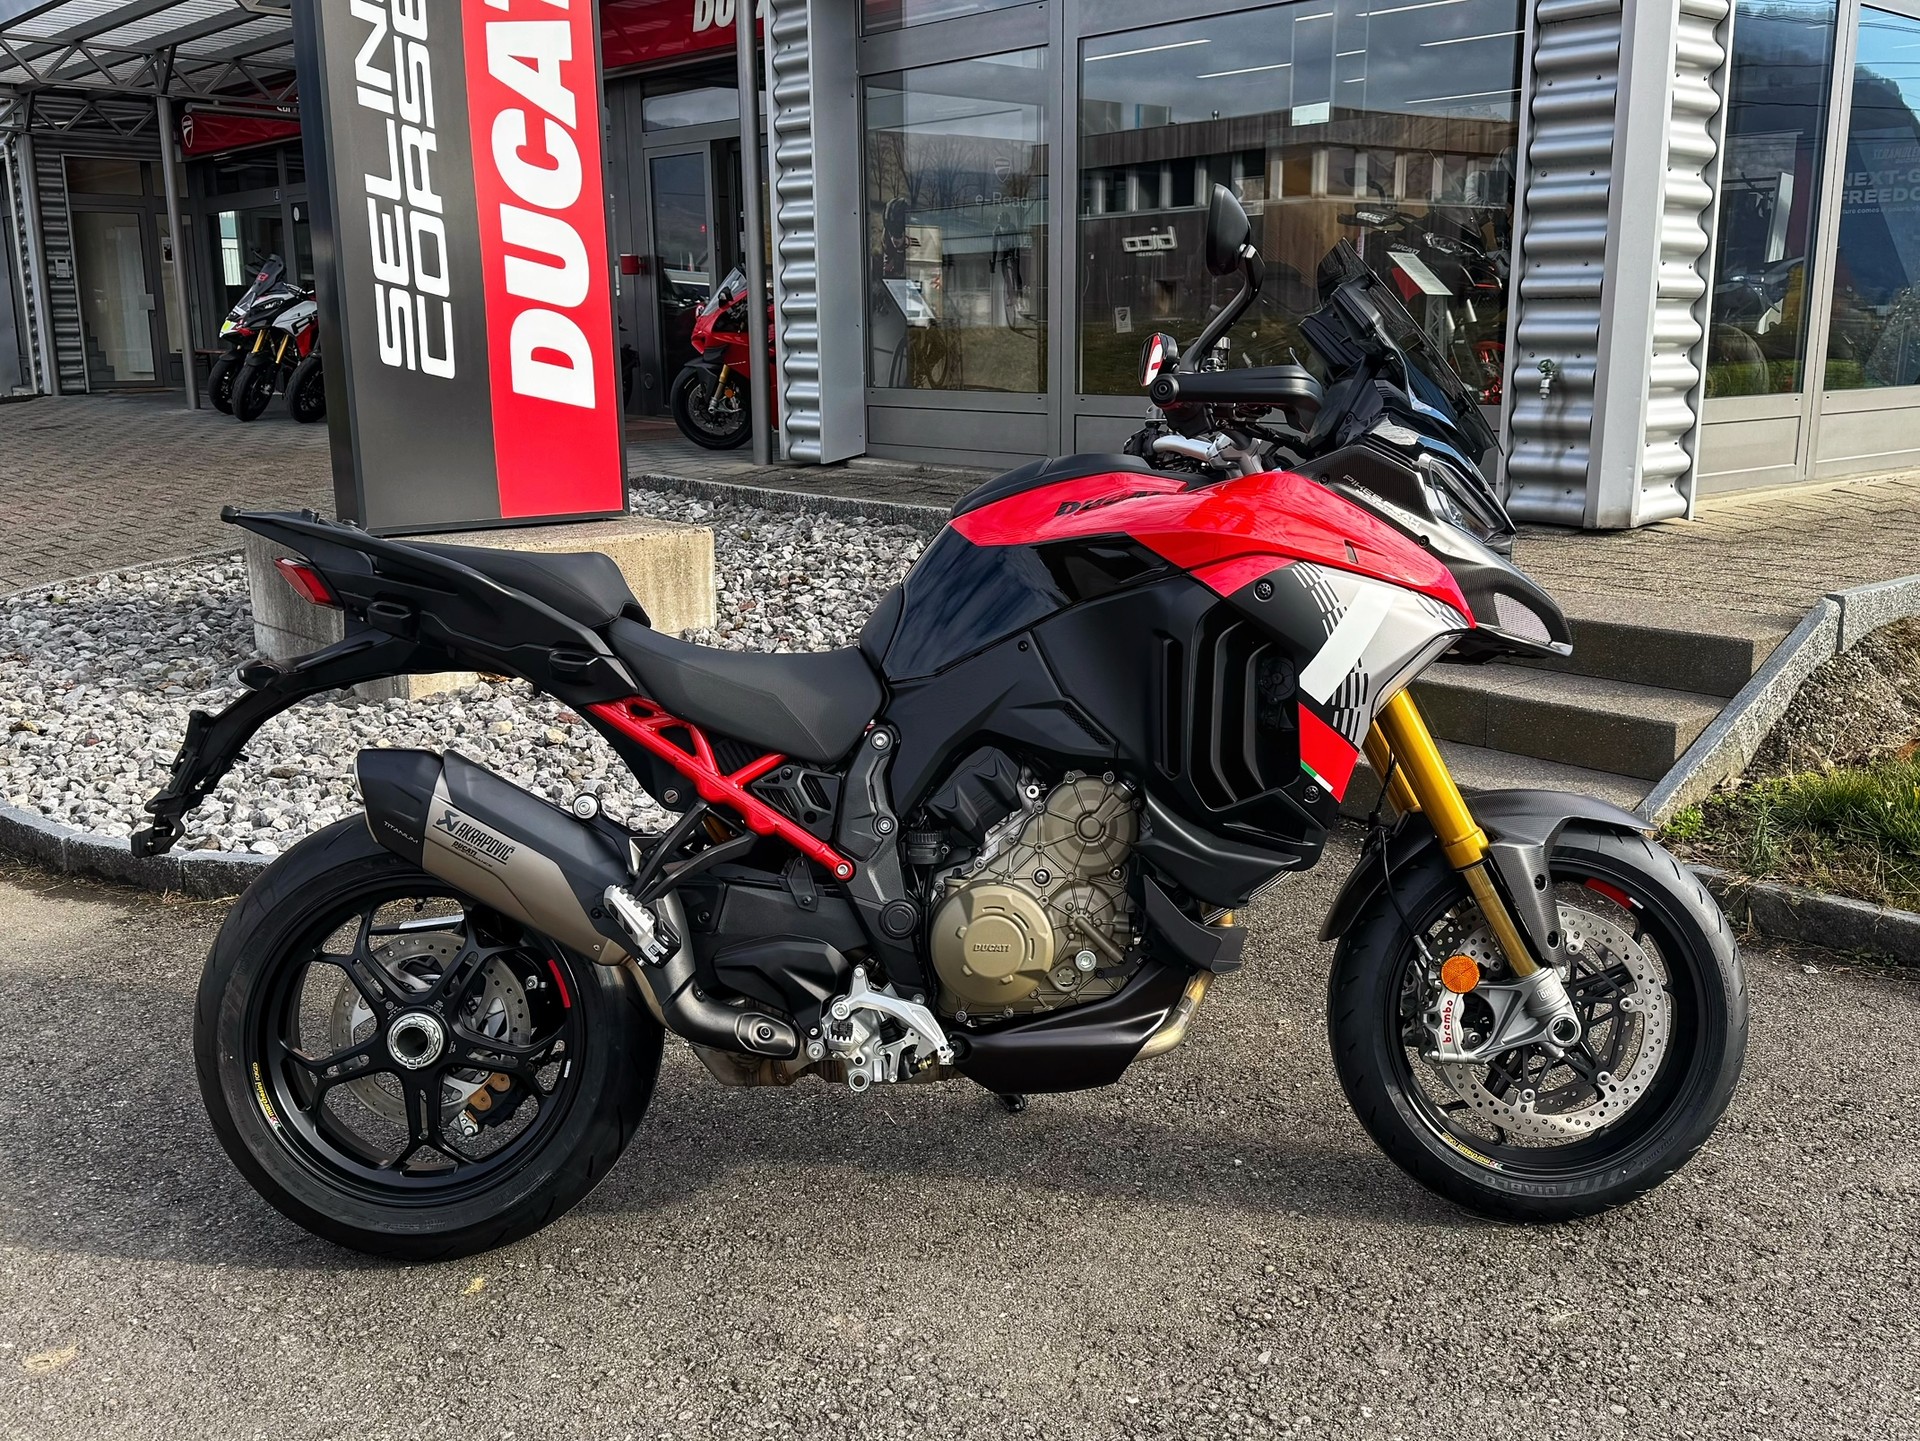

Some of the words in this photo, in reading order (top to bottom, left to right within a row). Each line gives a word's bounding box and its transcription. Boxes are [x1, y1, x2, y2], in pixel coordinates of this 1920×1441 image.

[350, 0, 416, 371] SELIN
[484, 0, 595, 409] DUCA
[975, 191, 1029, 209] e-Road
[1390, 242, 1420, 255] DUCATI
[452, 840, 478, 857] DUCATI
[973, 943, 1011, 952] DUCATI
[1442, 999, 1454, 1043] brembo
[255, 1081, 275, 1117] marchesini
[1484, 1174, 1559, 1196] DIABLO
